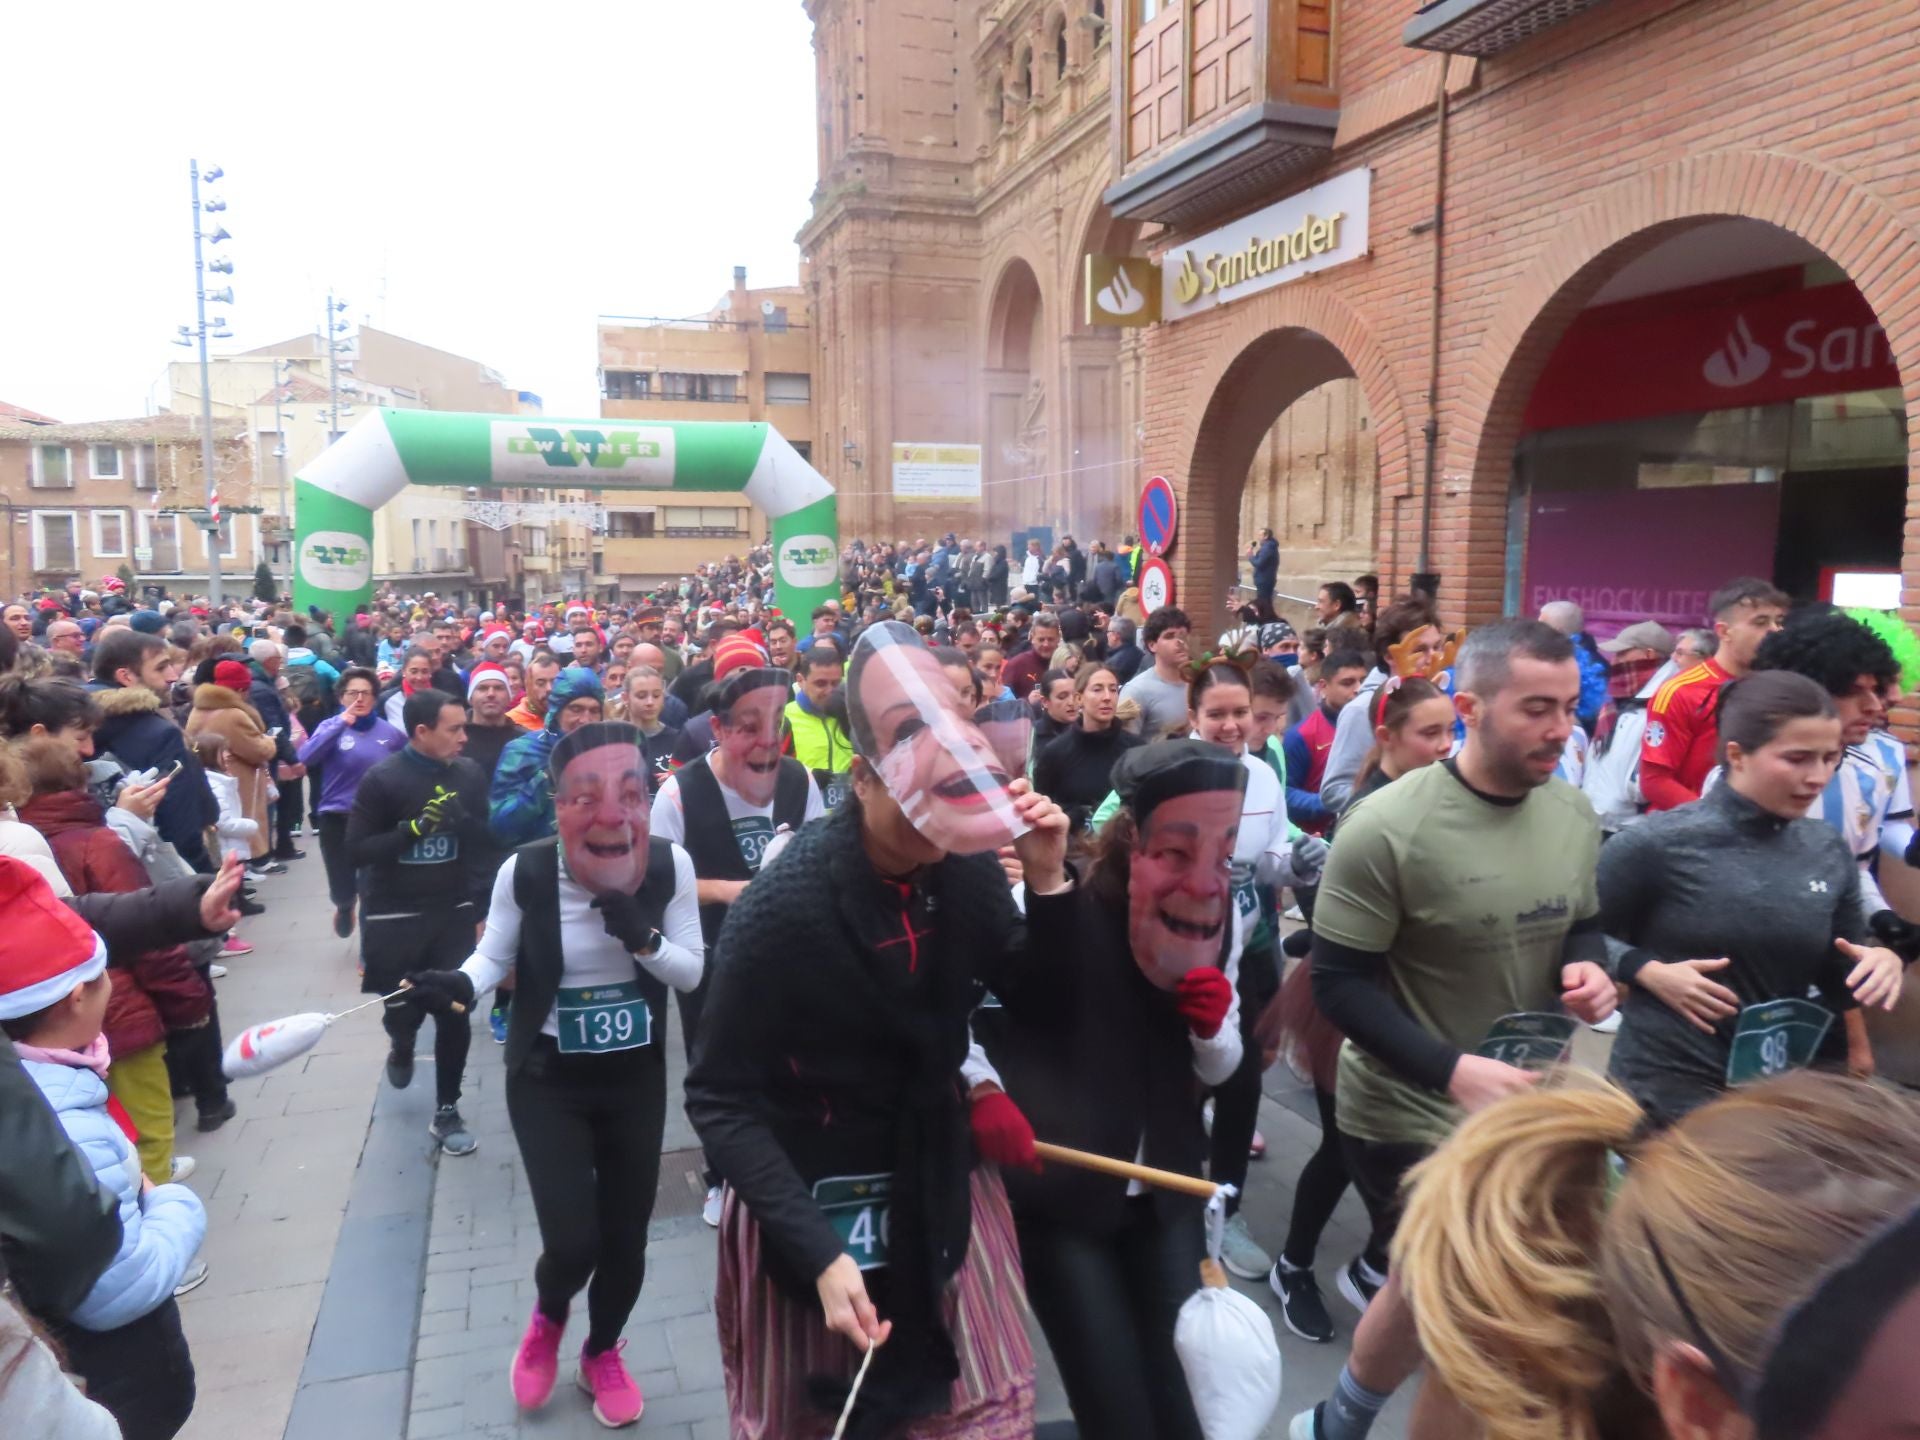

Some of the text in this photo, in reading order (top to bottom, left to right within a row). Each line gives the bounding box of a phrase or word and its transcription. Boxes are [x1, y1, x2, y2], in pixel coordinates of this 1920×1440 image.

[1202, 211, 1344, 295] Santander
[513, 439, 655, 456] TWINNER
[1566, 586, 1646, 613] SHOCK
[574, 1008, 633, 1044] 139
[1760, 1030, 1788, 1075] 98
